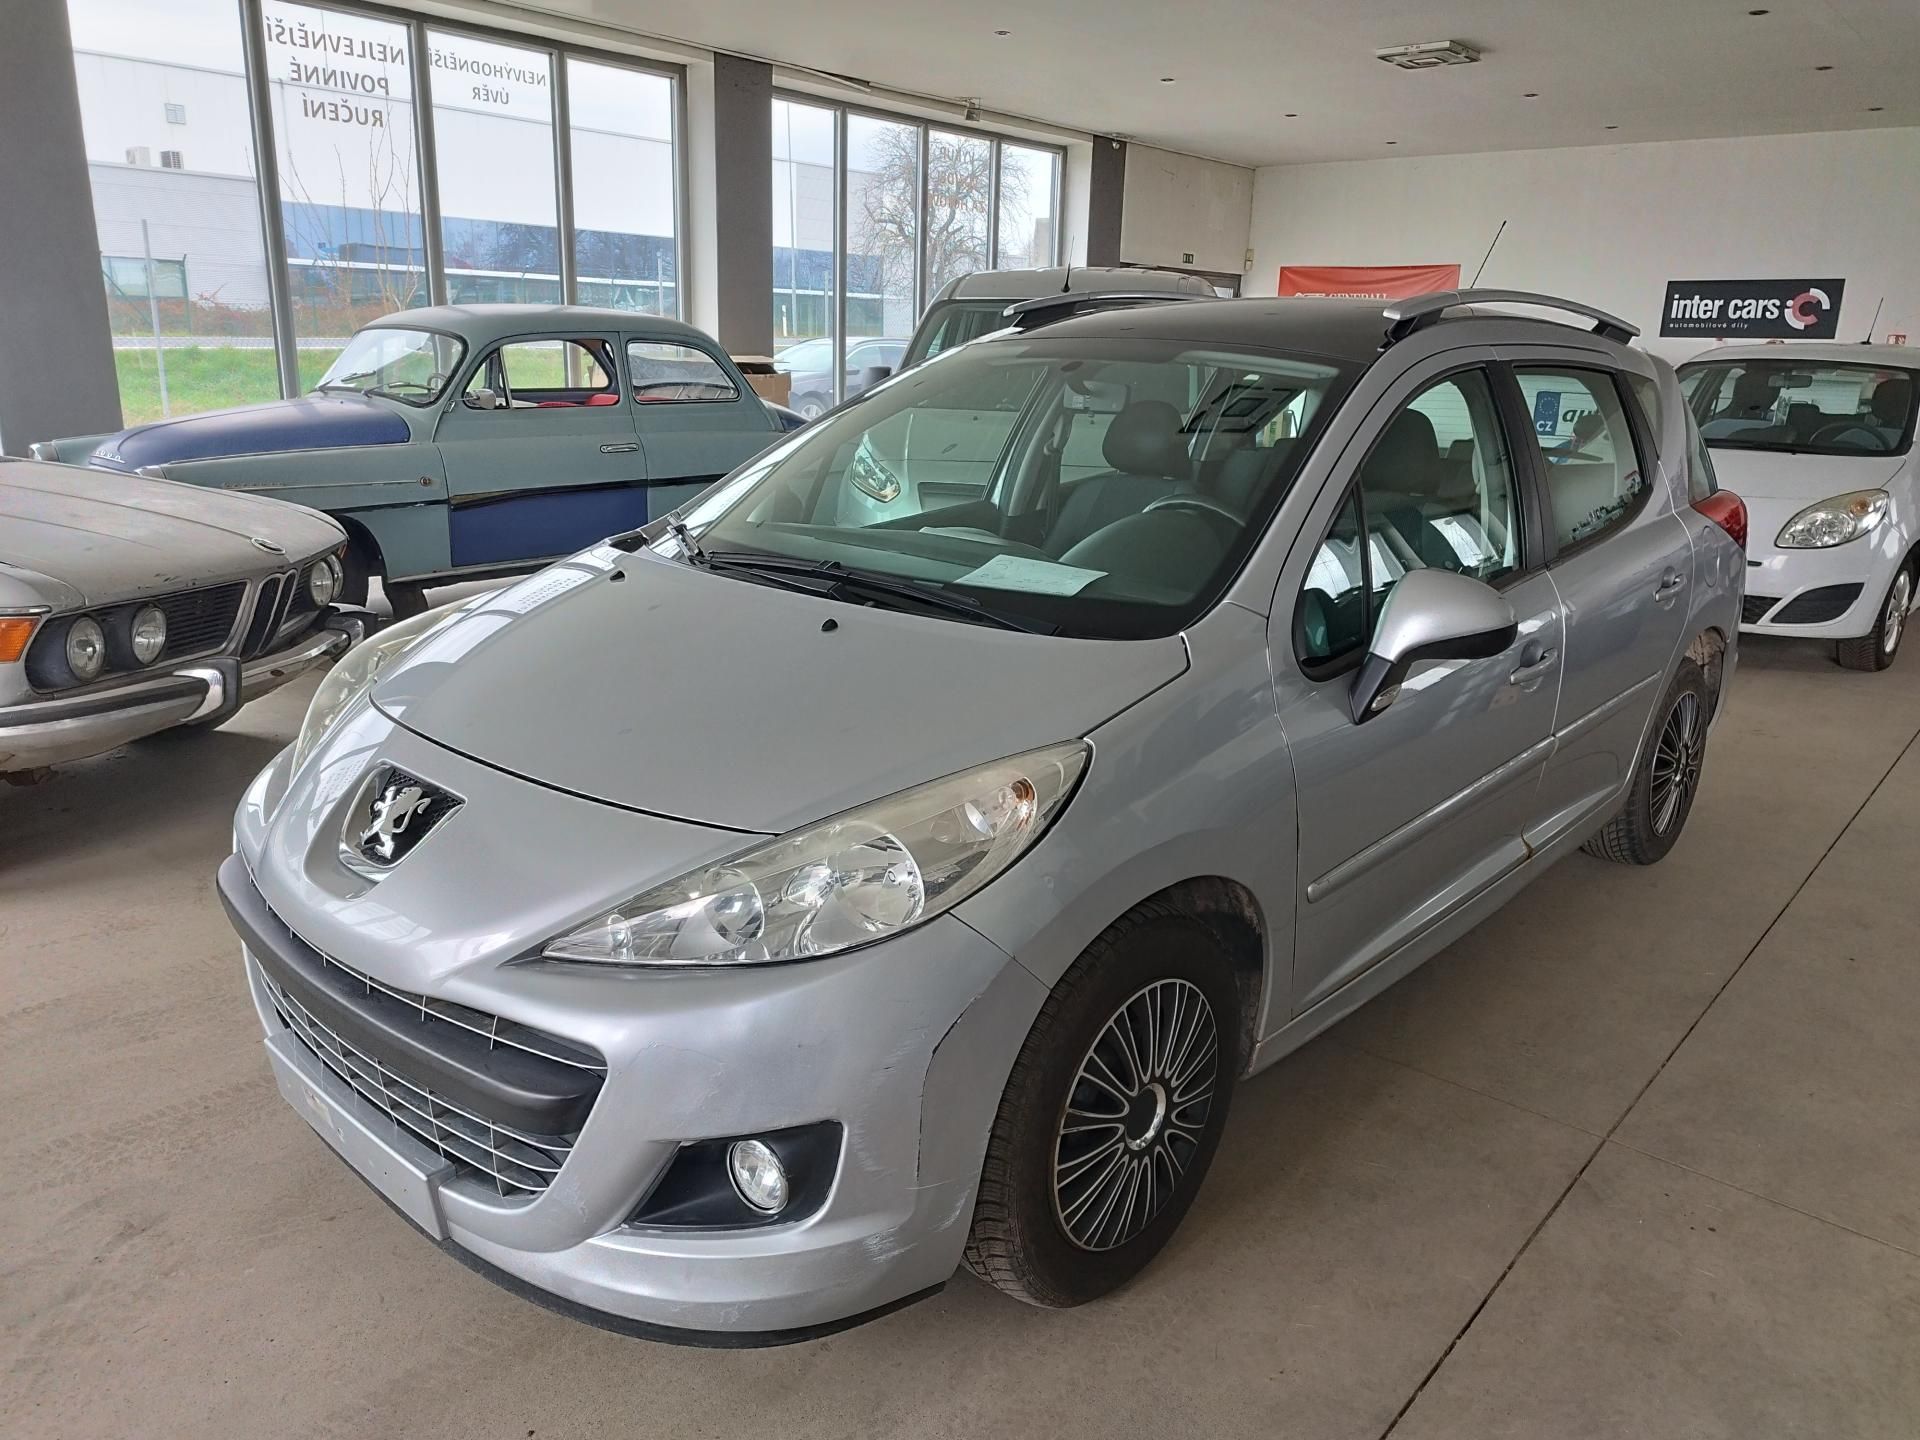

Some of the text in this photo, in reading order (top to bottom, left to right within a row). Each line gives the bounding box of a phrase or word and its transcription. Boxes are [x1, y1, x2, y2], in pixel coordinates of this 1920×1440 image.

[1671, 294, 1780, 319] inter cars
[1536, 420, 1553, 432] CZ
